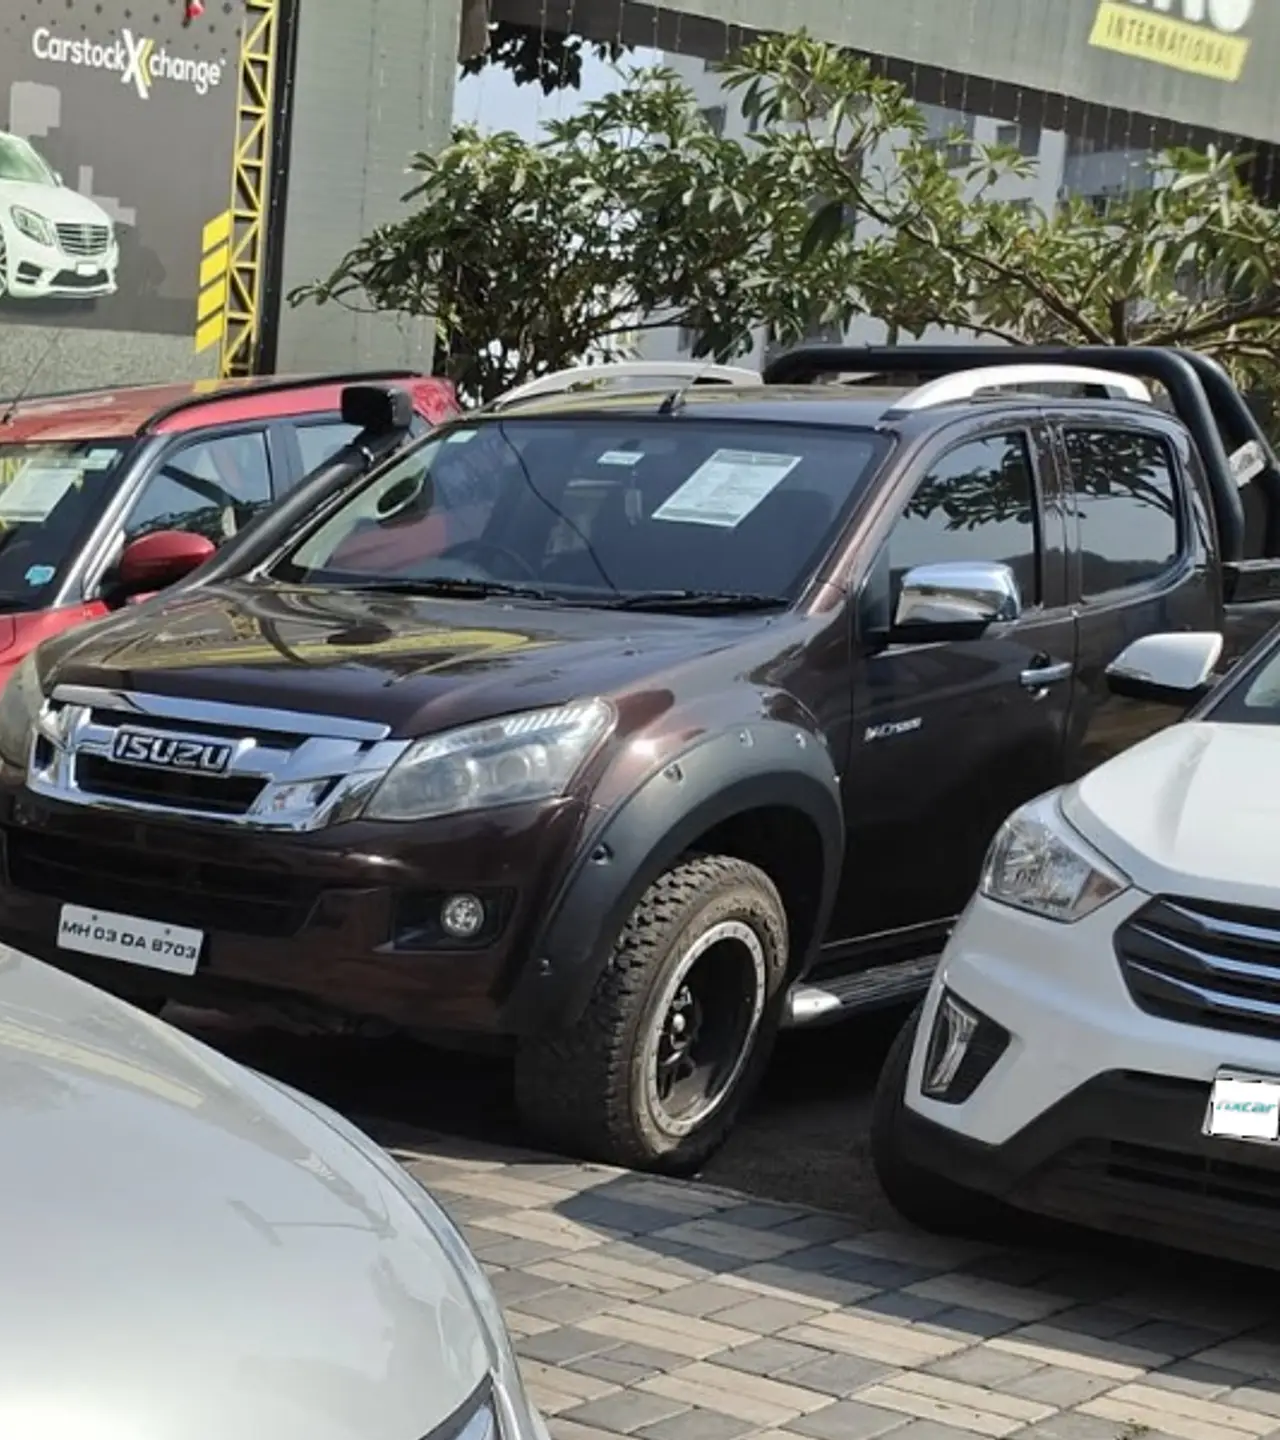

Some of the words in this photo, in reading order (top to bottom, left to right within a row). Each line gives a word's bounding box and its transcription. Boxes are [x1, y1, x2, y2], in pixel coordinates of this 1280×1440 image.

[1107, 12, 1233, 70] INTERNATIONAL
[116, 733, 230, 769] ISUZU
[62, 920, 91, 938] MH
[93, 926, 117, 943] 03
